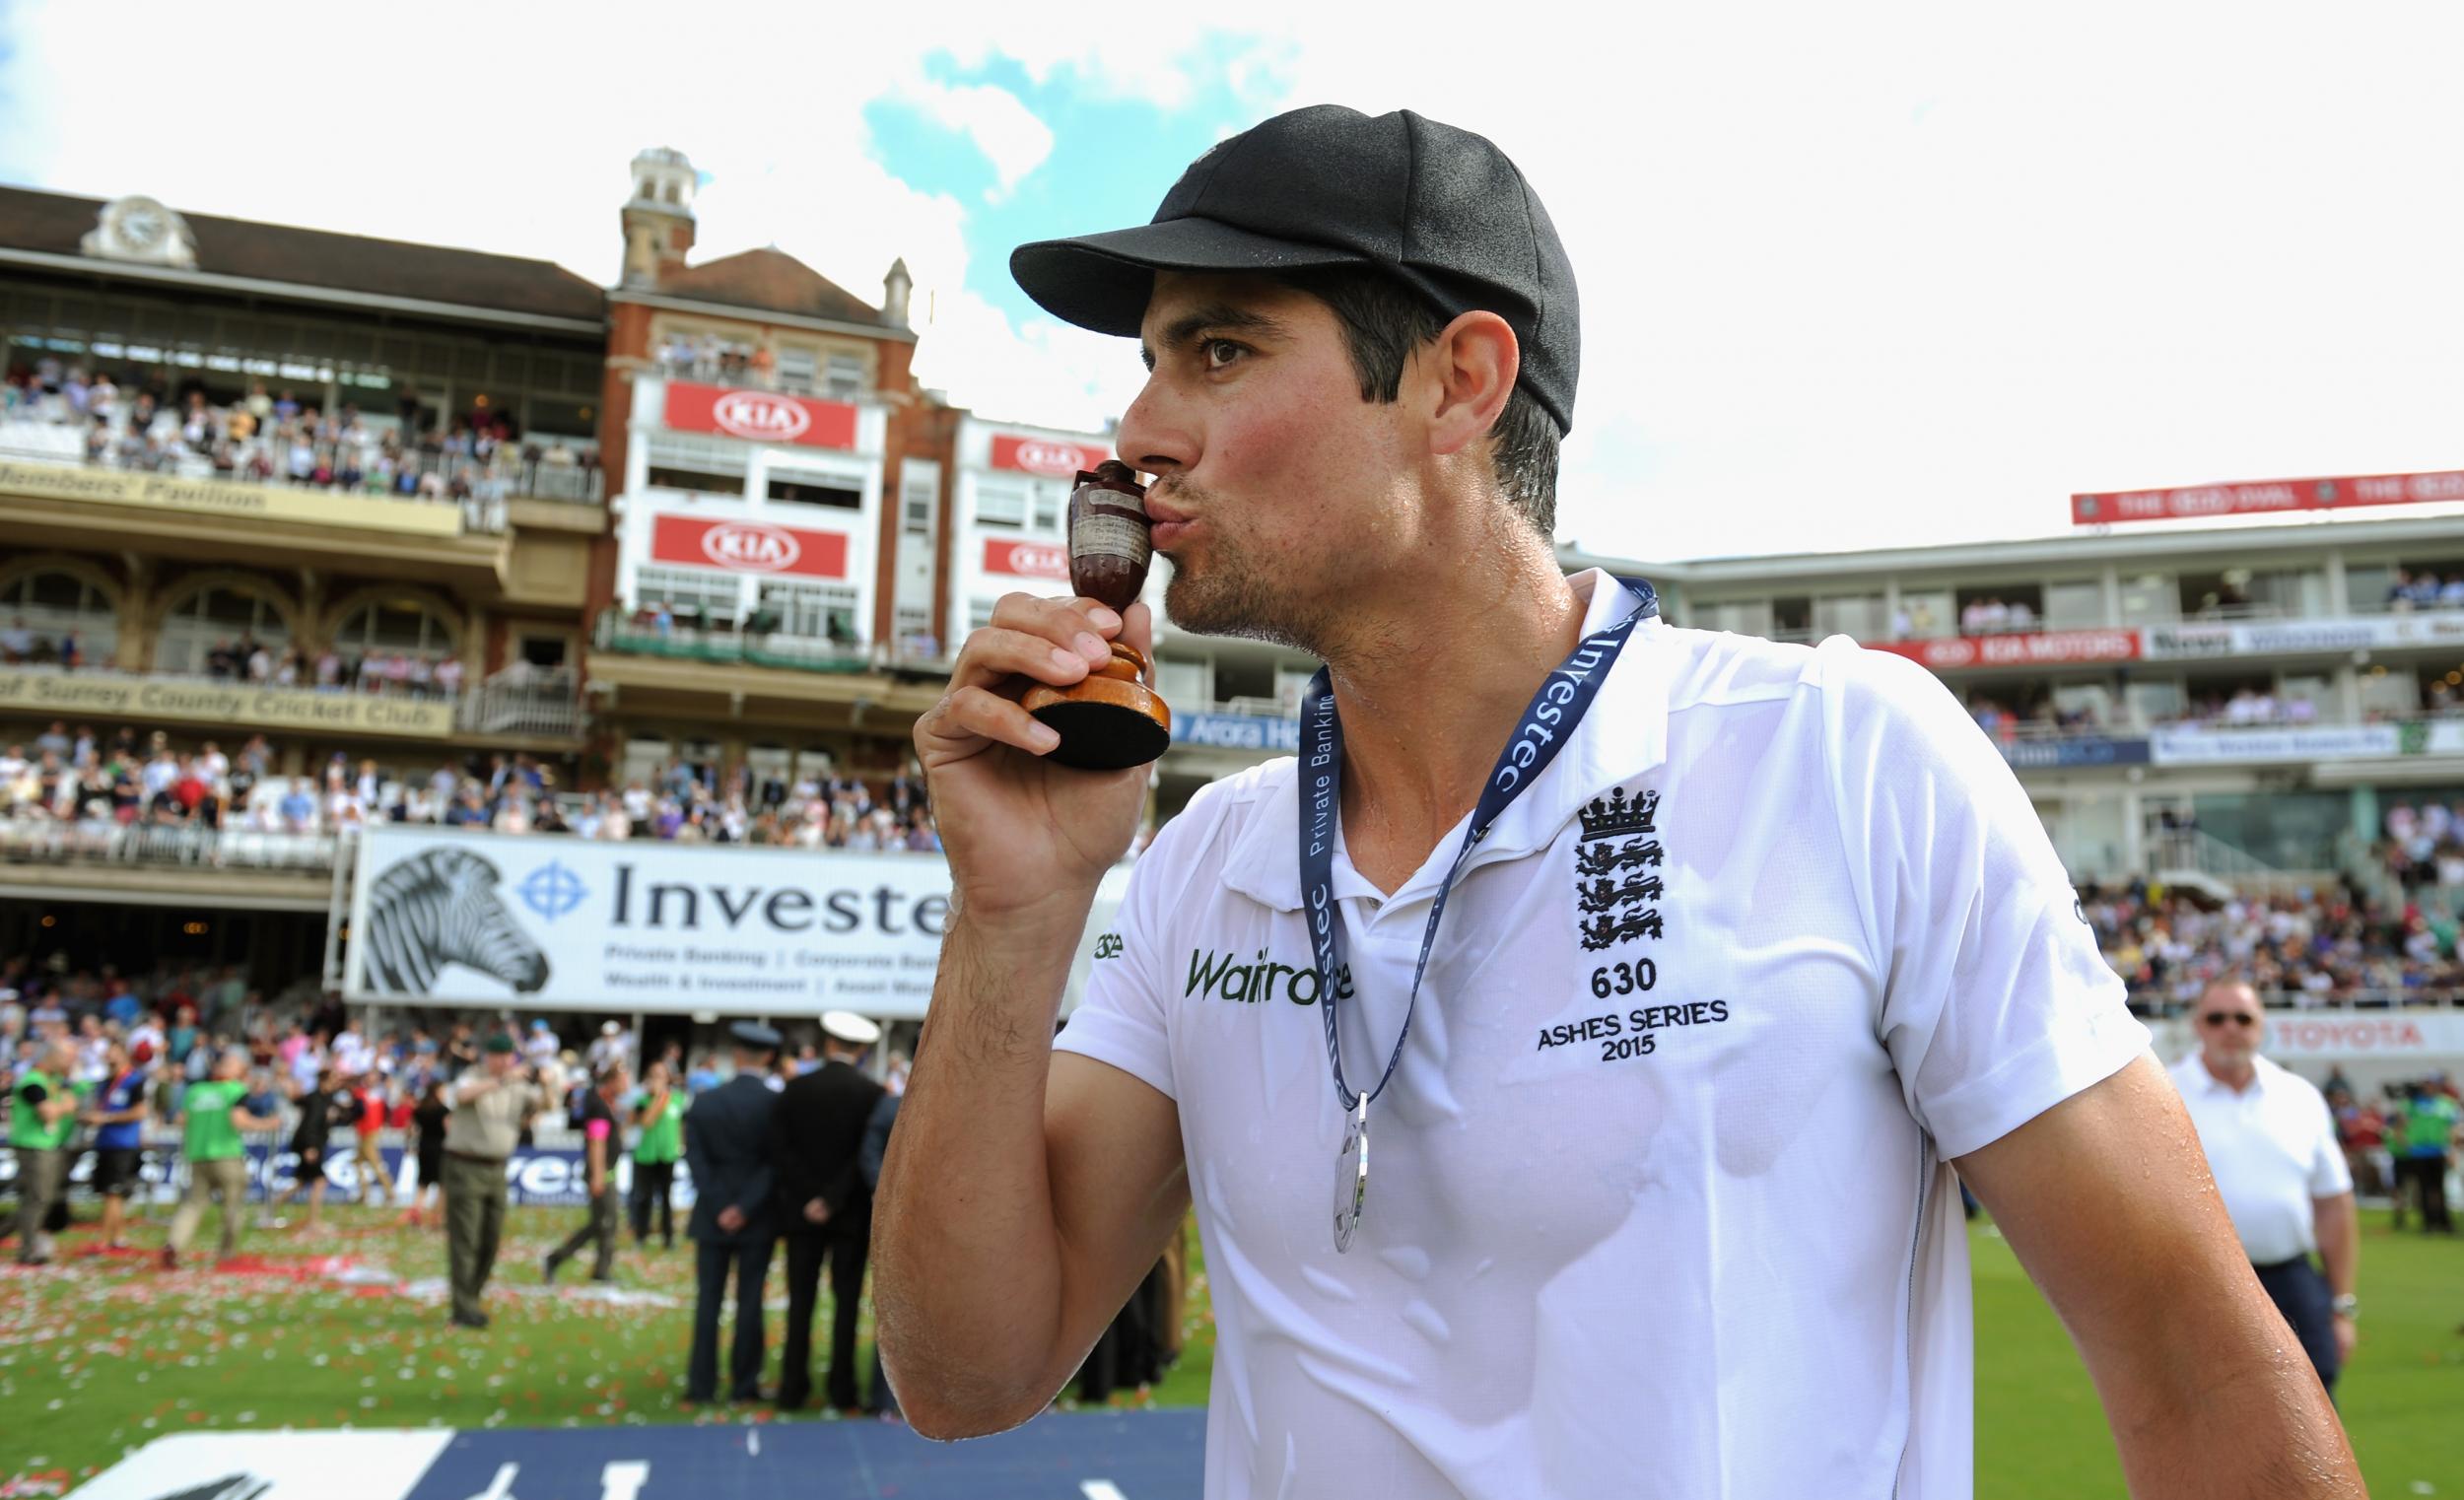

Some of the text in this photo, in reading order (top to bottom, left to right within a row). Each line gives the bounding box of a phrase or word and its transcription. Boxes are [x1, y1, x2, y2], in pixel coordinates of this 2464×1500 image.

[731, 401, 792, 430] KIA
[144, 481, 267, 510] Pavilion
[2236, 484, 2297, 509] OVAL
[719, 532, 783, 566] KIA
[1980, 637, 2025, 662] KIA
[2028, 633, 2133, 659] MOTORS
[32, 676, 128, 713] Surrey
[140, 681, 242, 720] County
[253, 687, 356, 720] Cricket
[366, 694, 434, 725] Club
[1496, 639, 1620, 792] Investec
[1309, 775, 1331, 857] Private
[1186, 946, 1354, 1005] Wairoe
[1312, 883, 1338, 1069] vestec
[1591, 957, 1657, 998] 630
[1538, 999, 1729, 1051] ASHES SERIES
[2279, 1019, 2426, 1051] TOYOTA
[1602, 1034, 1656, 1062] 2015
